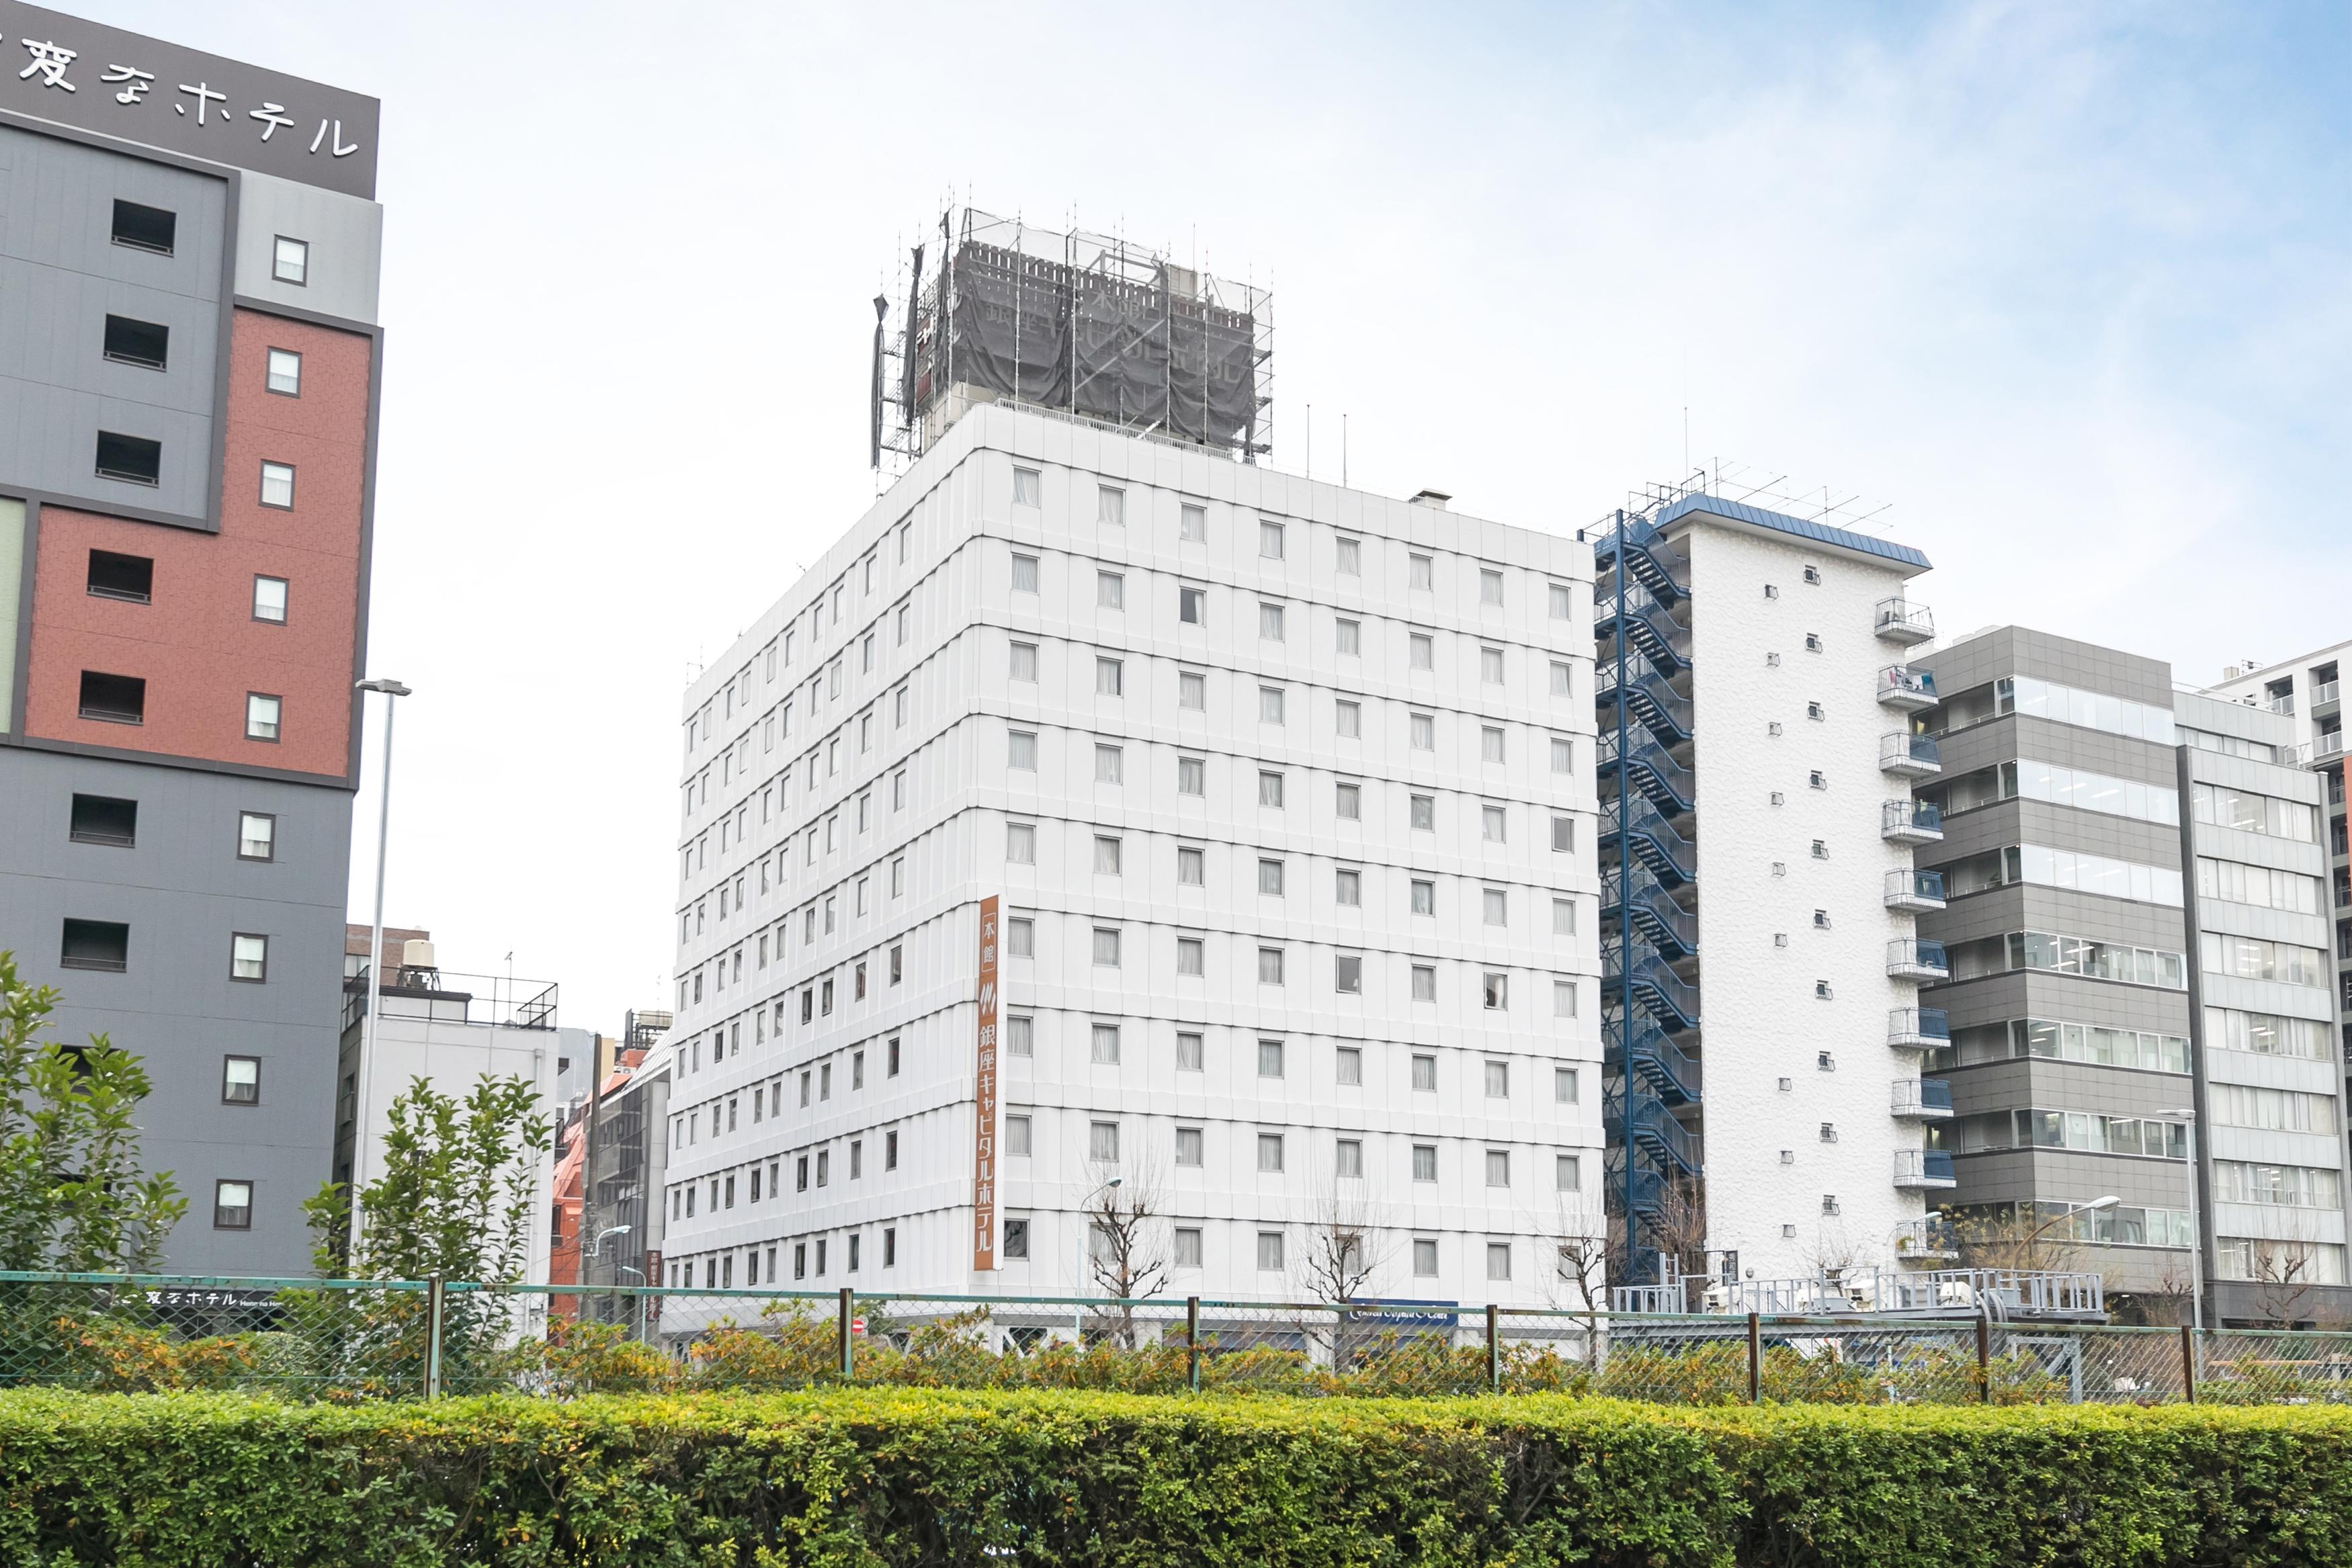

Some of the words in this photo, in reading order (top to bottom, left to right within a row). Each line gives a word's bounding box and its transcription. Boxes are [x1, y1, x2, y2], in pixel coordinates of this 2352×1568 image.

[19, 38, 360, 157] 変なホテル
[983, 921, 995, 963] 本館
[976, 1024, 995, 1252] 銀座キャピタルホテル
[146, 1291, 237, 1305] 変なホテル
